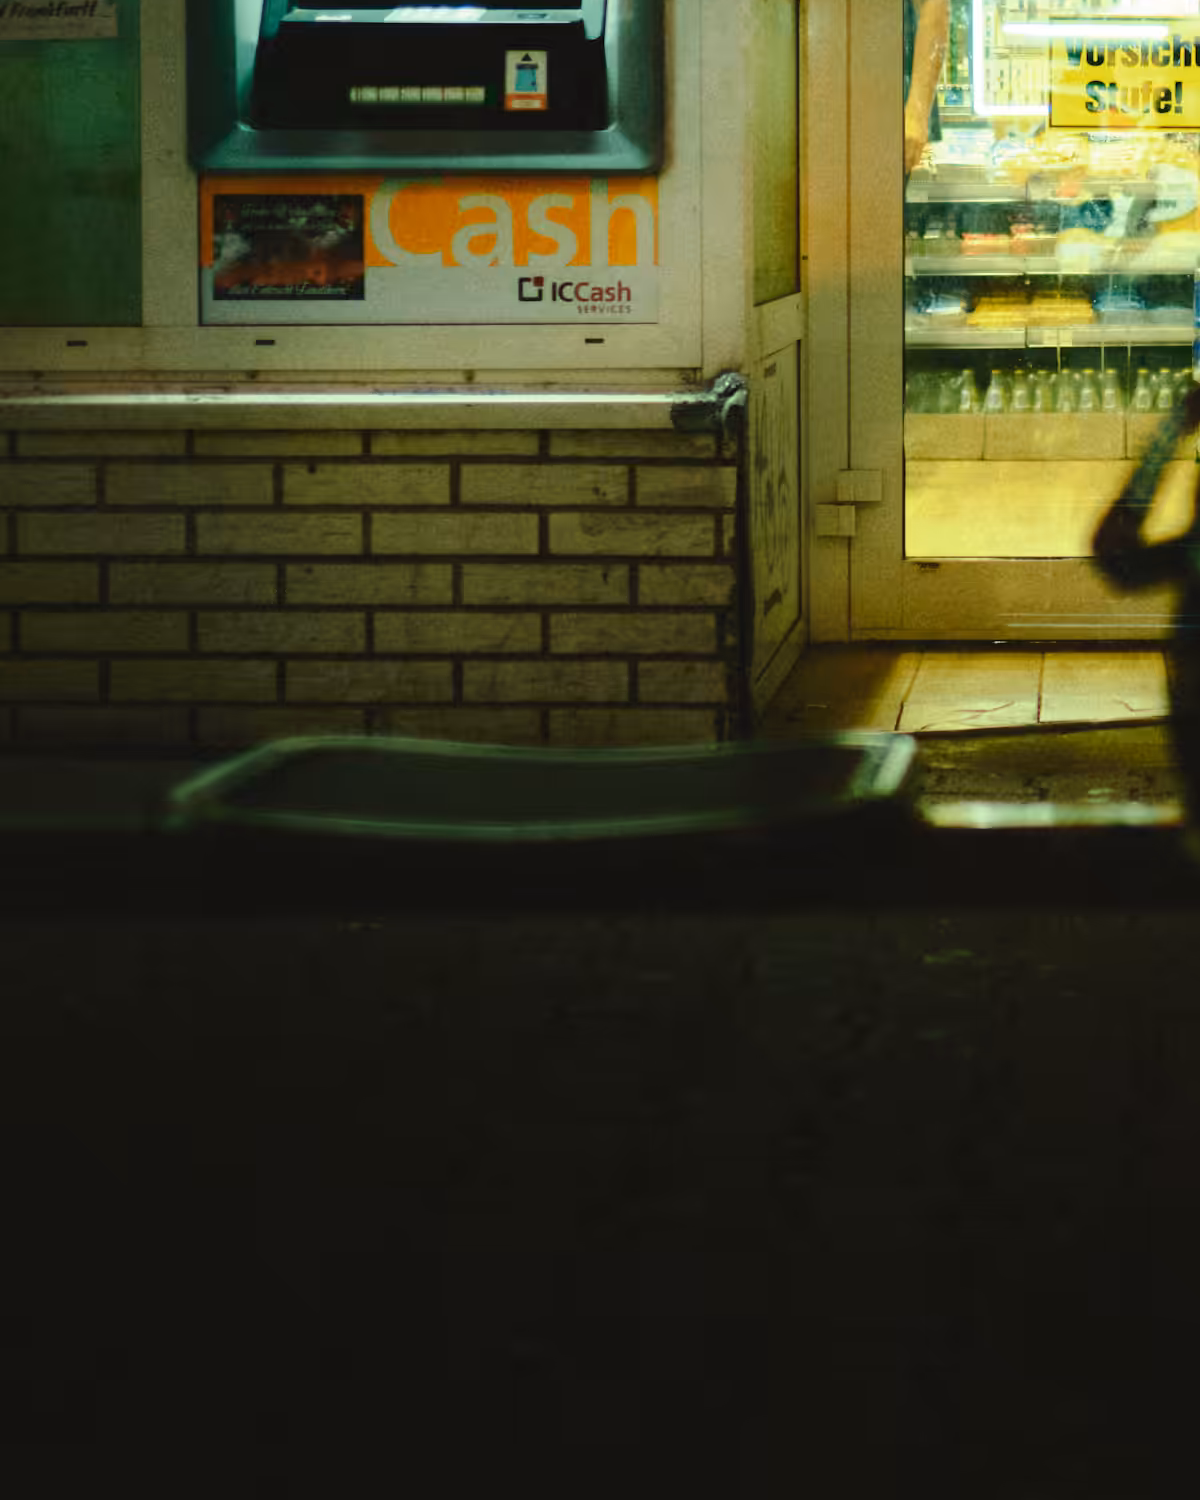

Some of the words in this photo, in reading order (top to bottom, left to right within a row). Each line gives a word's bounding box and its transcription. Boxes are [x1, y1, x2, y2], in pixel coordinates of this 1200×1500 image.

[1086, 80, 1183, 114] Stufe!
[370, 176, 654, 268] Cash
[551, 281, 632, 302] ICCash
[577, 304, 632, 314] SERVICES
